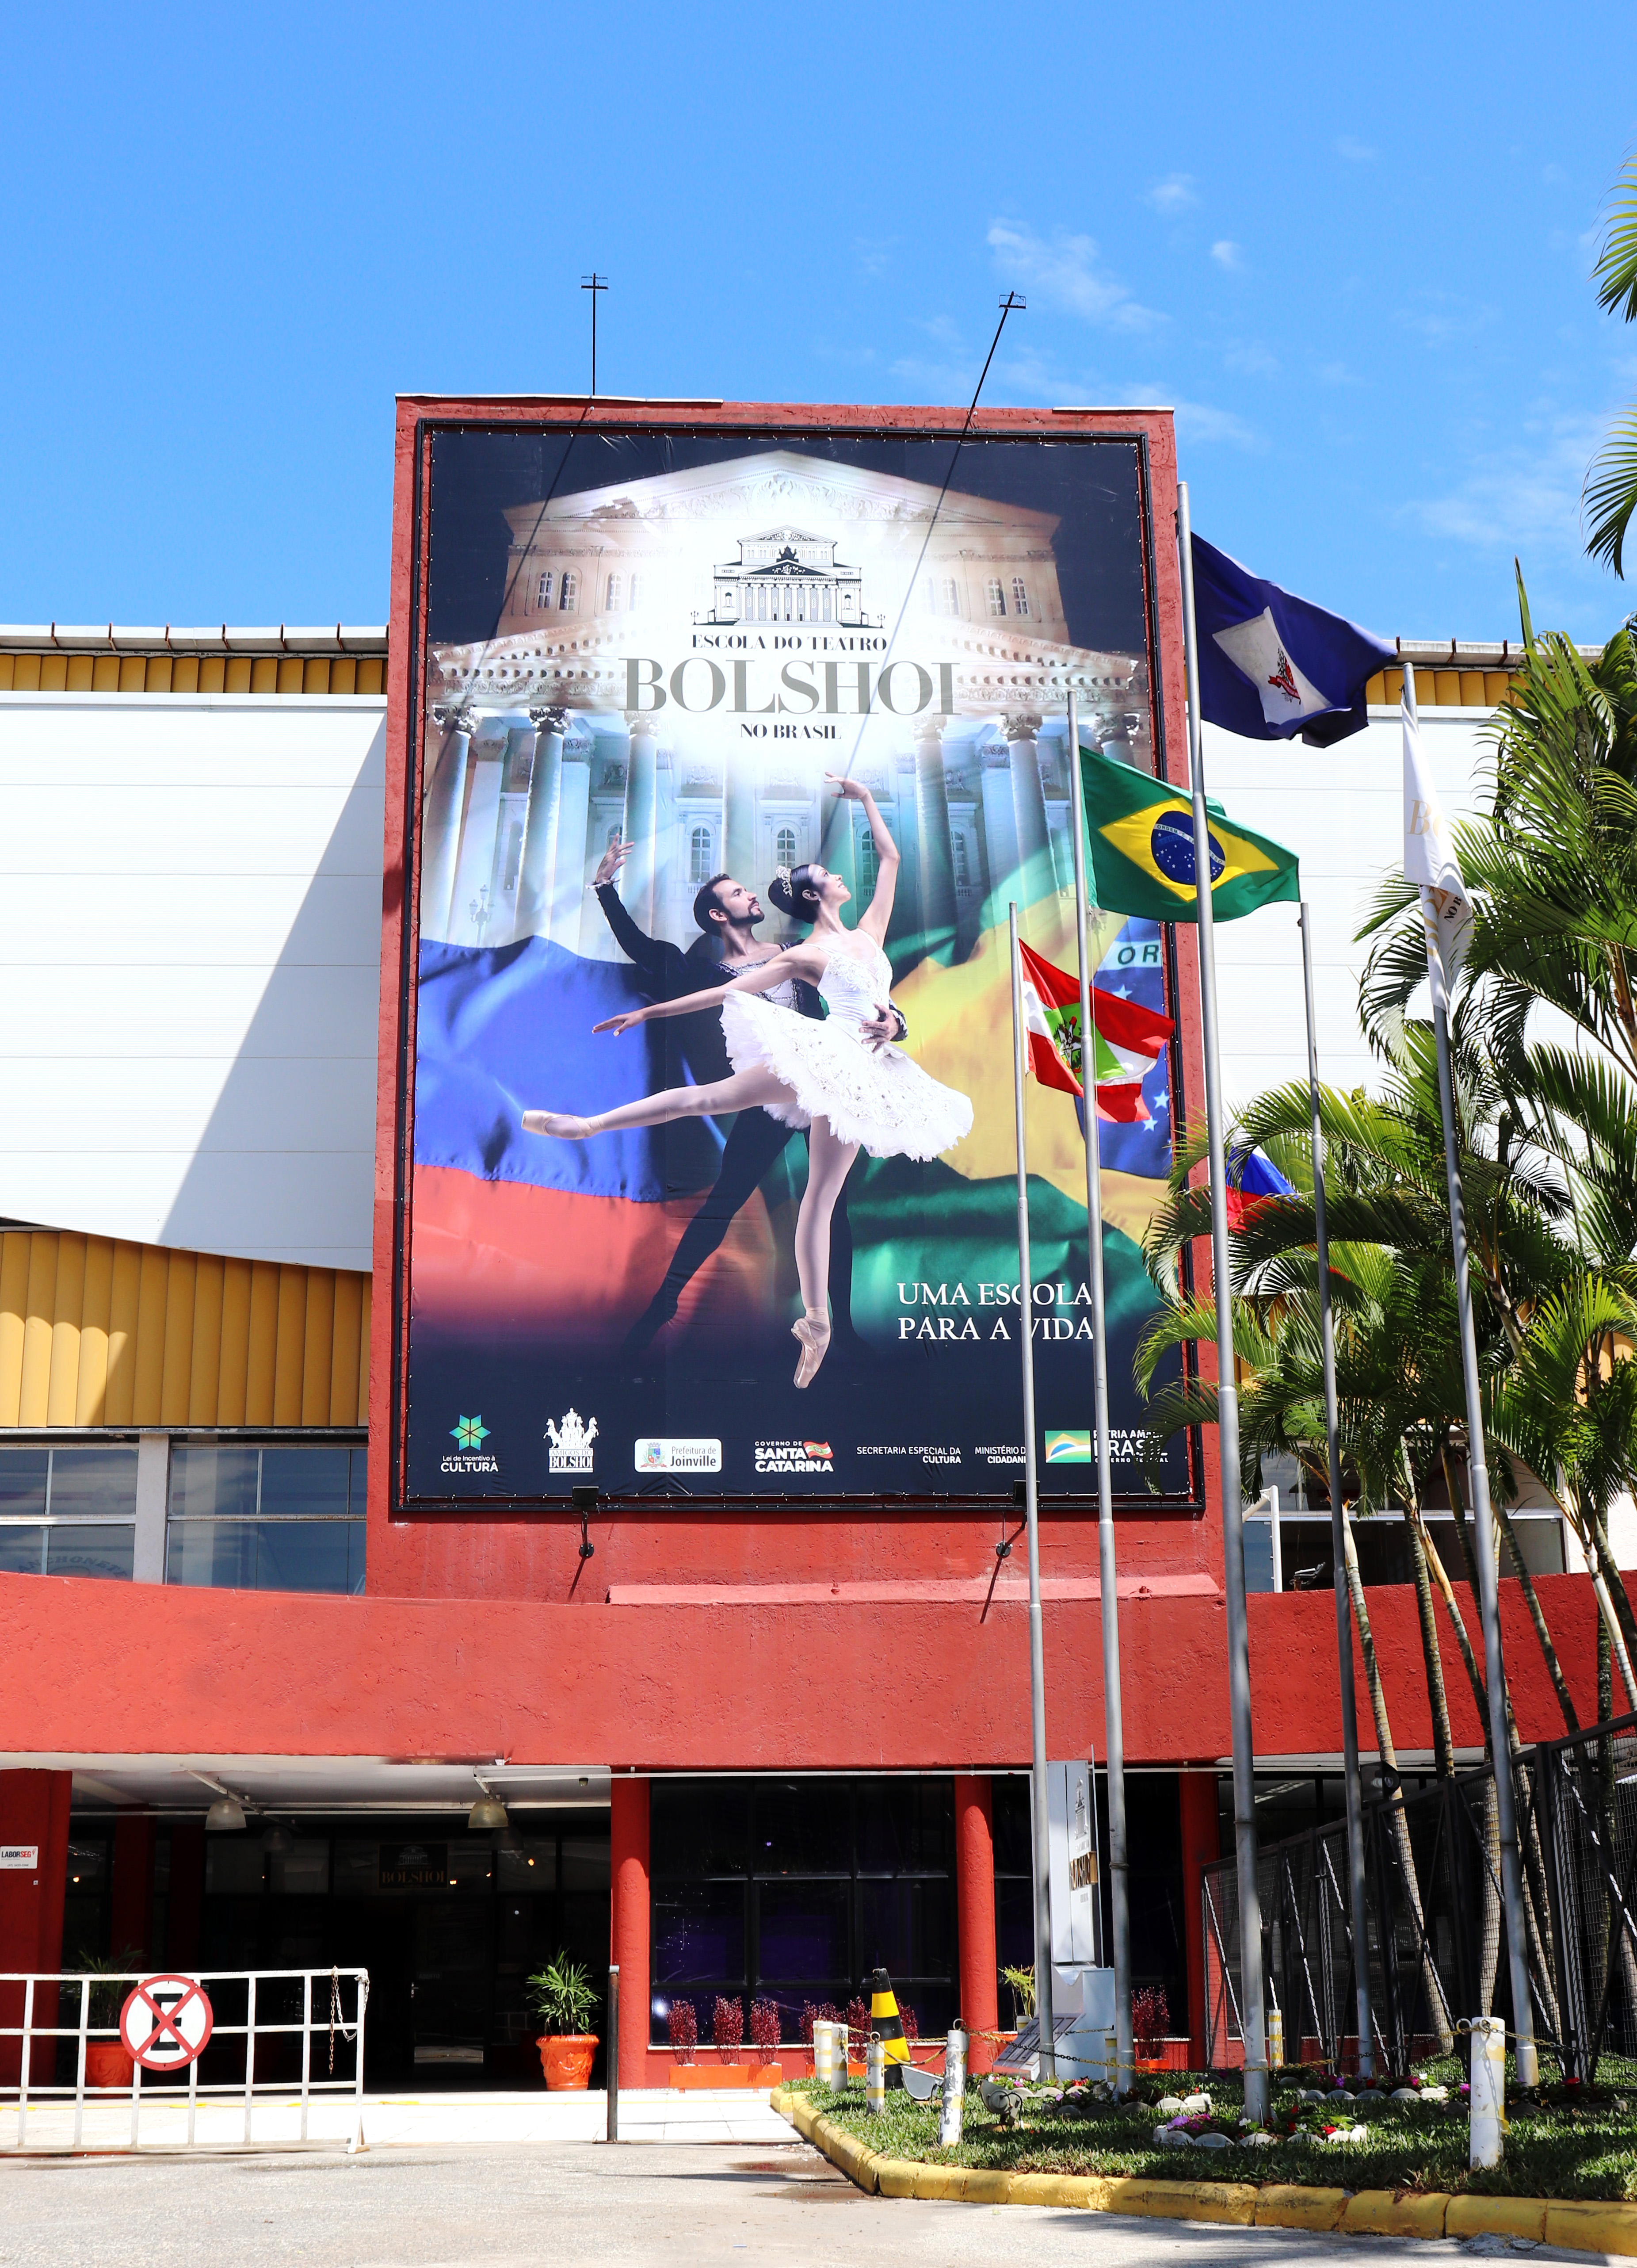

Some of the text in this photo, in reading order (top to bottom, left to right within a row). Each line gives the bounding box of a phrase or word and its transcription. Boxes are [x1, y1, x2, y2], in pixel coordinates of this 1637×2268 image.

[692, 634, 887, 652] ESCOLA DO TEATRO
[618, 657, 962, 716] BOLSHOI
[740, 723, 842, 740] NO BRASIL
[1157, 824, 1178, 834] ORDEM
[897, 1282, 1092, 1305] UMA ESCOLA
[898, 1316, 981, 1340] PARA
[989, 1316, 1011, 1340] A
[1093, 1430, 1128, 1438] PRIA
[672, 1446, 716, 1454] Prefeitura de
[755, 1448, 807, 1459] SANTA
[908, 1446, 948, 1455] ESPECIAL
[975, 1445, 1019, 1454] MINISTÉRIO
[549, 1456, 593, 1468] BOLSHOI
[670, 1455, 716, 1466] Joinville
[755, 1460, 834, 1472] CATARINA
[440, 1462, 499, 1472] CULTURA
[382, 1871, 445, 1883] BOLSHOI
